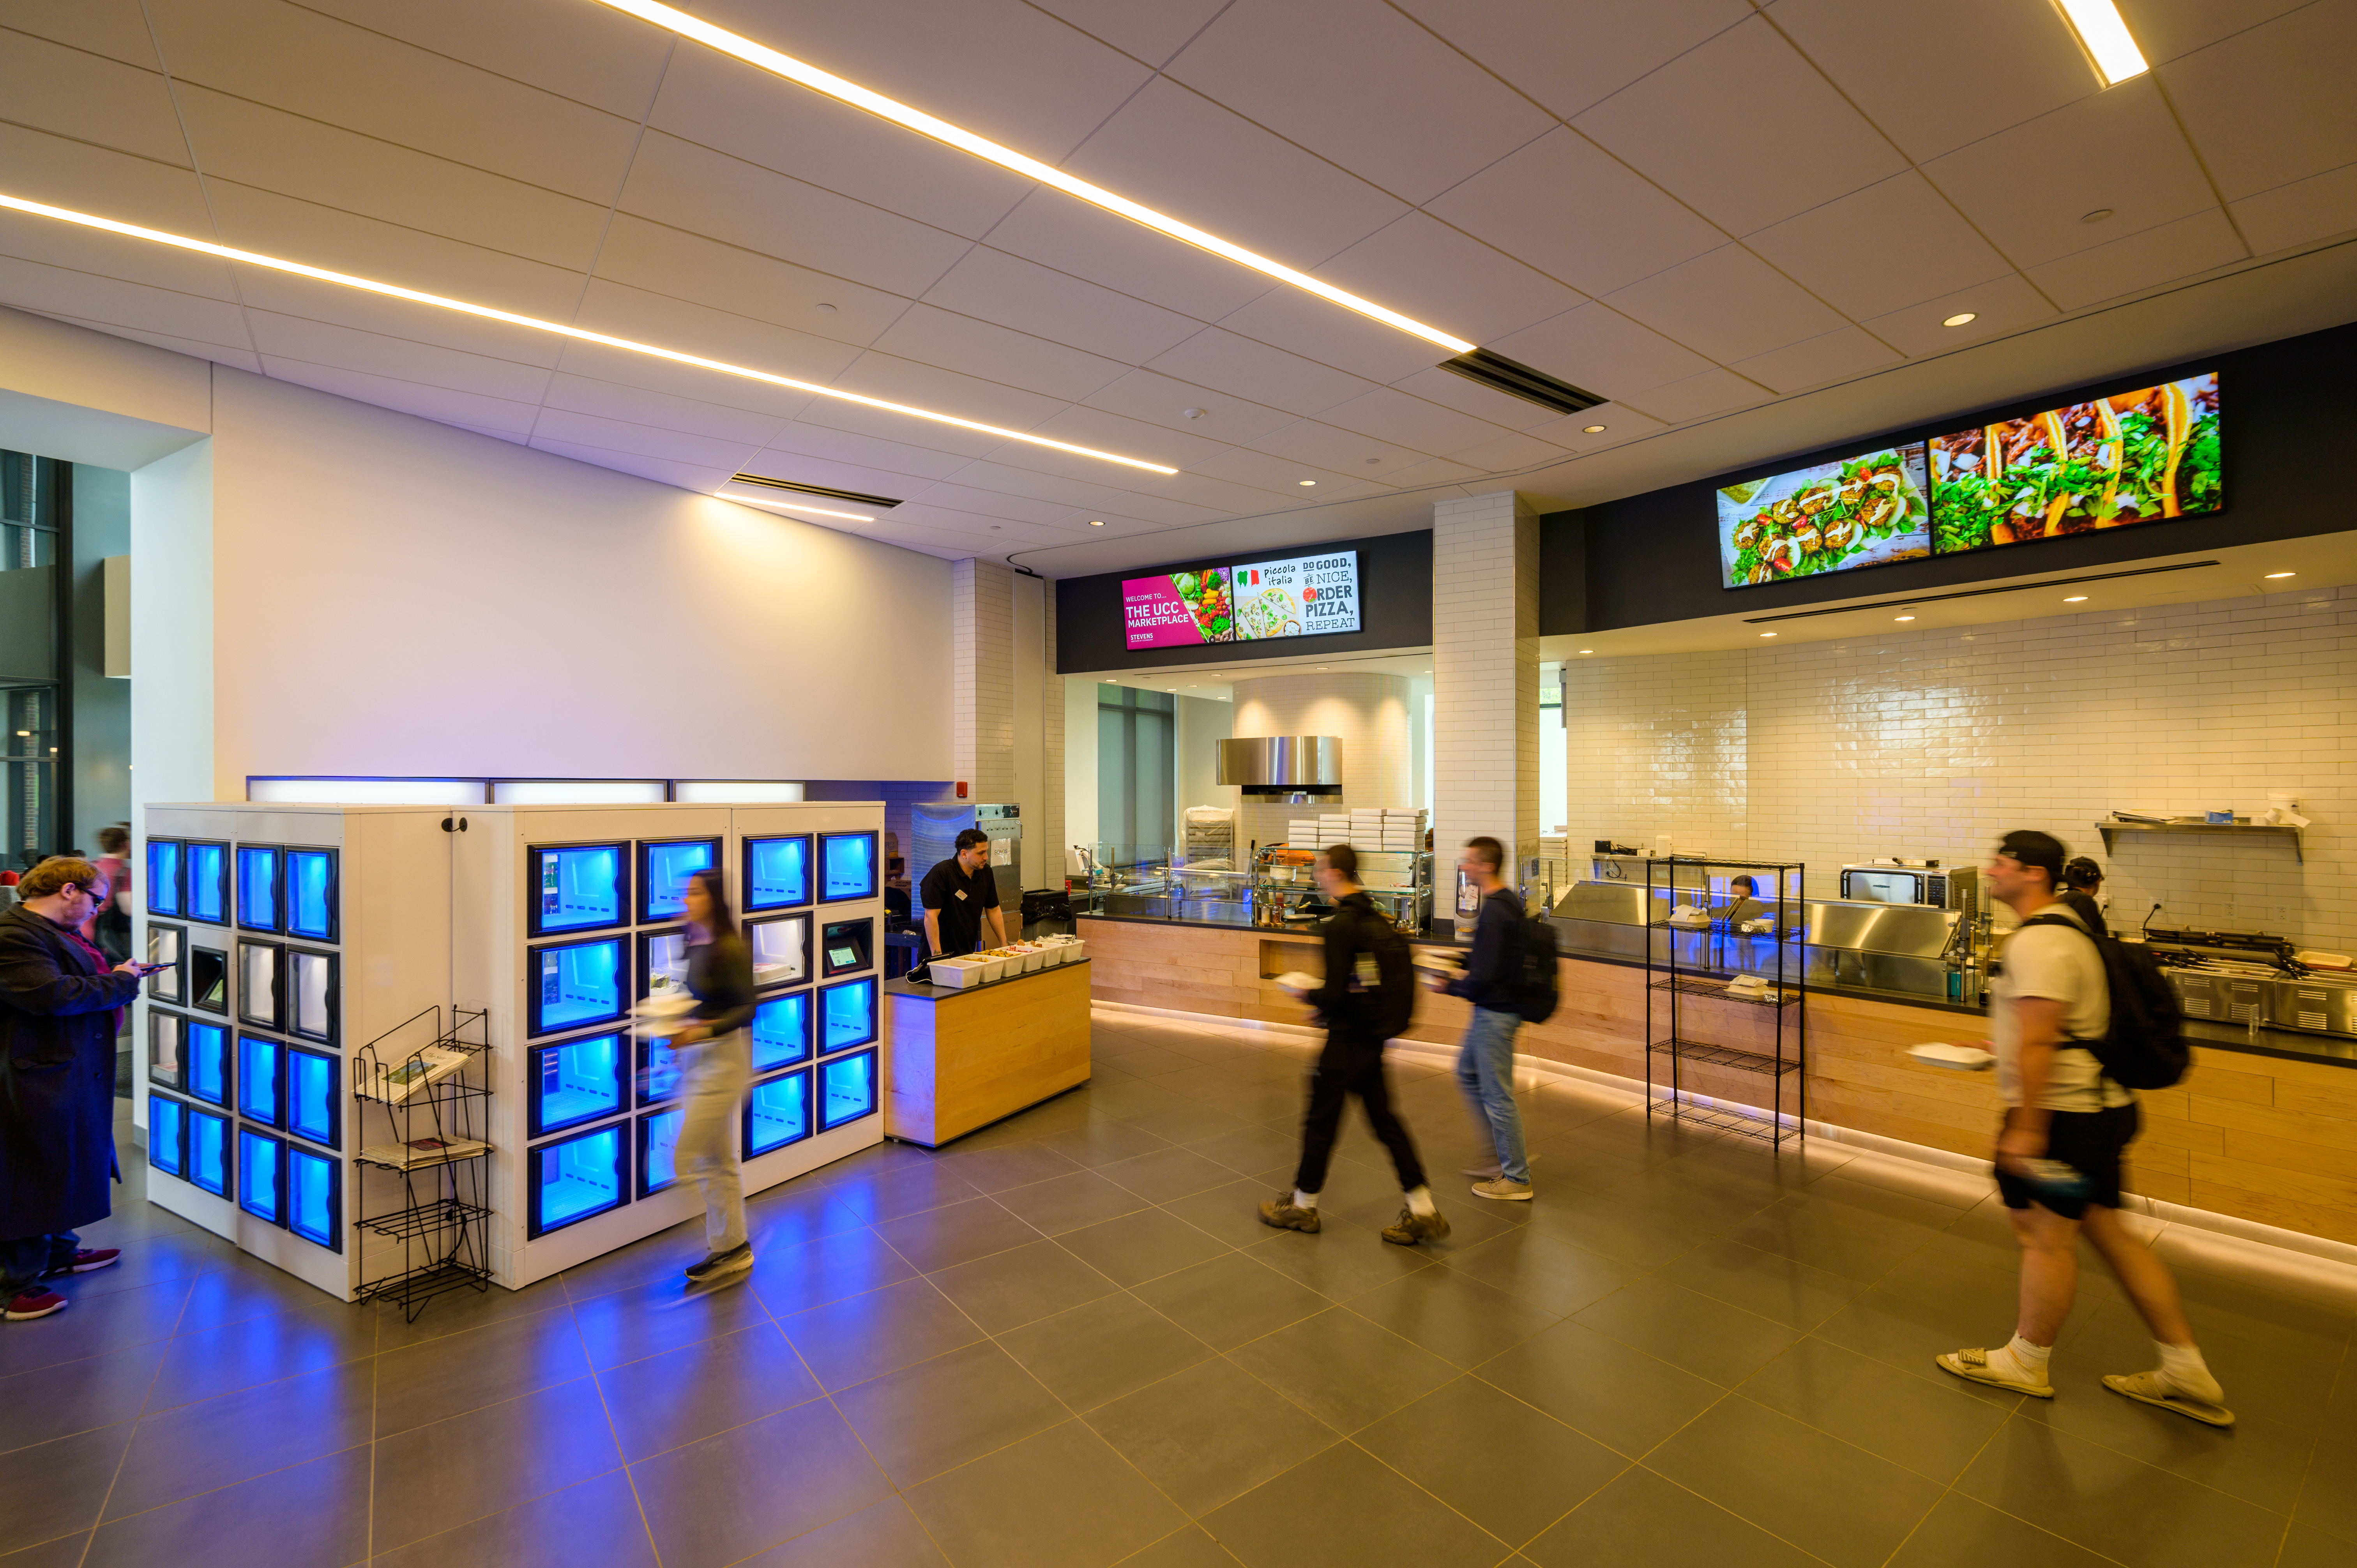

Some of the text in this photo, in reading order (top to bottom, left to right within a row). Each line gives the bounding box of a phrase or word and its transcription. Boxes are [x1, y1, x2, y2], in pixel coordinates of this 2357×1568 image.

[1264, 564, 1296, 578] piccola
[1316, 558, 1351, 570] GOOD,
[1269, 576, 1292, 586] italia
[1305, 570, 1352, 585] BE NICE,
[1126, 594, 1152, 602] WELCOME
[1126, 601, 1179, 618] THE UCC
[1306, 601, 1353, 617] PIZZA,
[1128, 614, 1189, 628] MARKETPLACE
[1306, 618, 1355, 631] REPEAT
